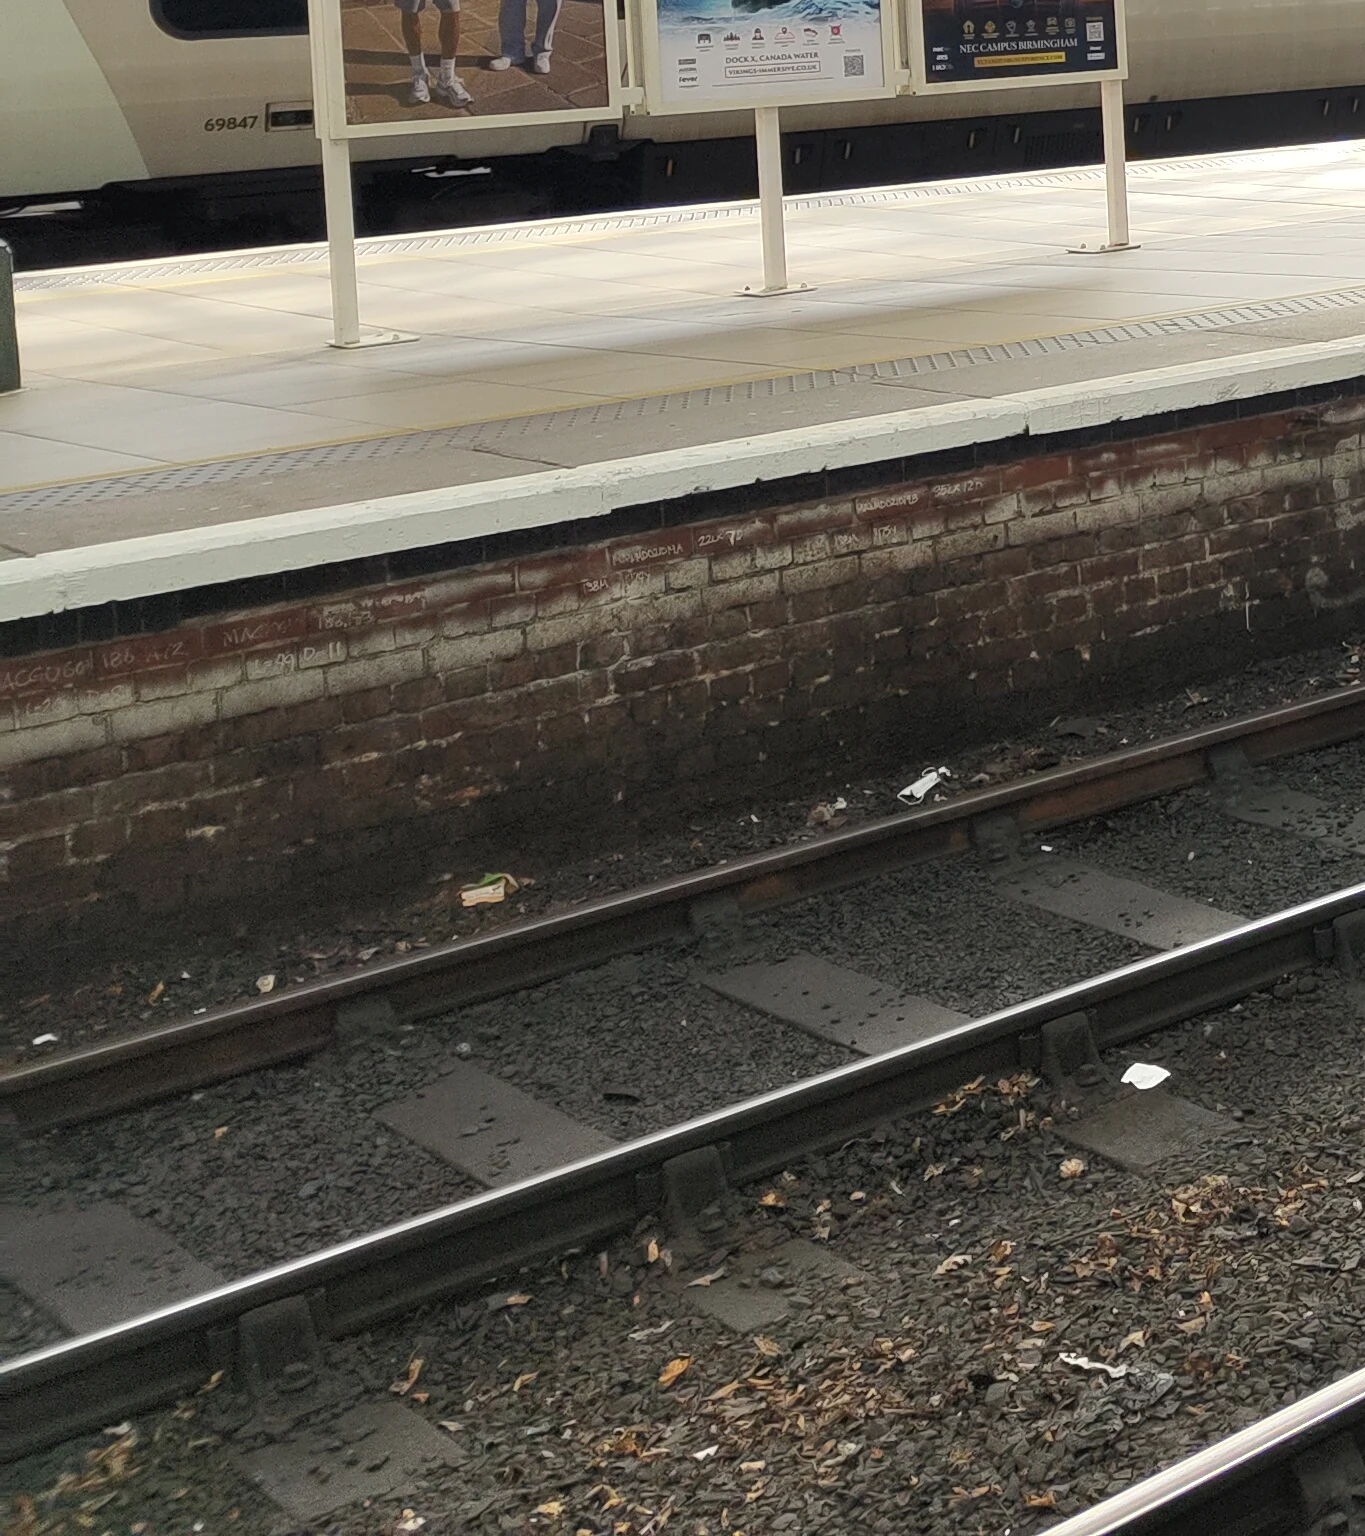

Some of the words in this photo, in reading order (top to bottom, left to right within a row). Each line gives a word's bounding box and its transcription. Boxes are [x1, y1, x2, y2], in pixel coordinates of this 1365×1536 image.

[959, 43, 979, 54] NEC
[979, 41, 1018, 52] CAMPUS
[1018, 38, 1077, 49] BIRMINGHAM
[725, 56, 749, 64] DOCK
[759, 53, 792, 62] CANADA
[204, 115, 259, 132] 69847
